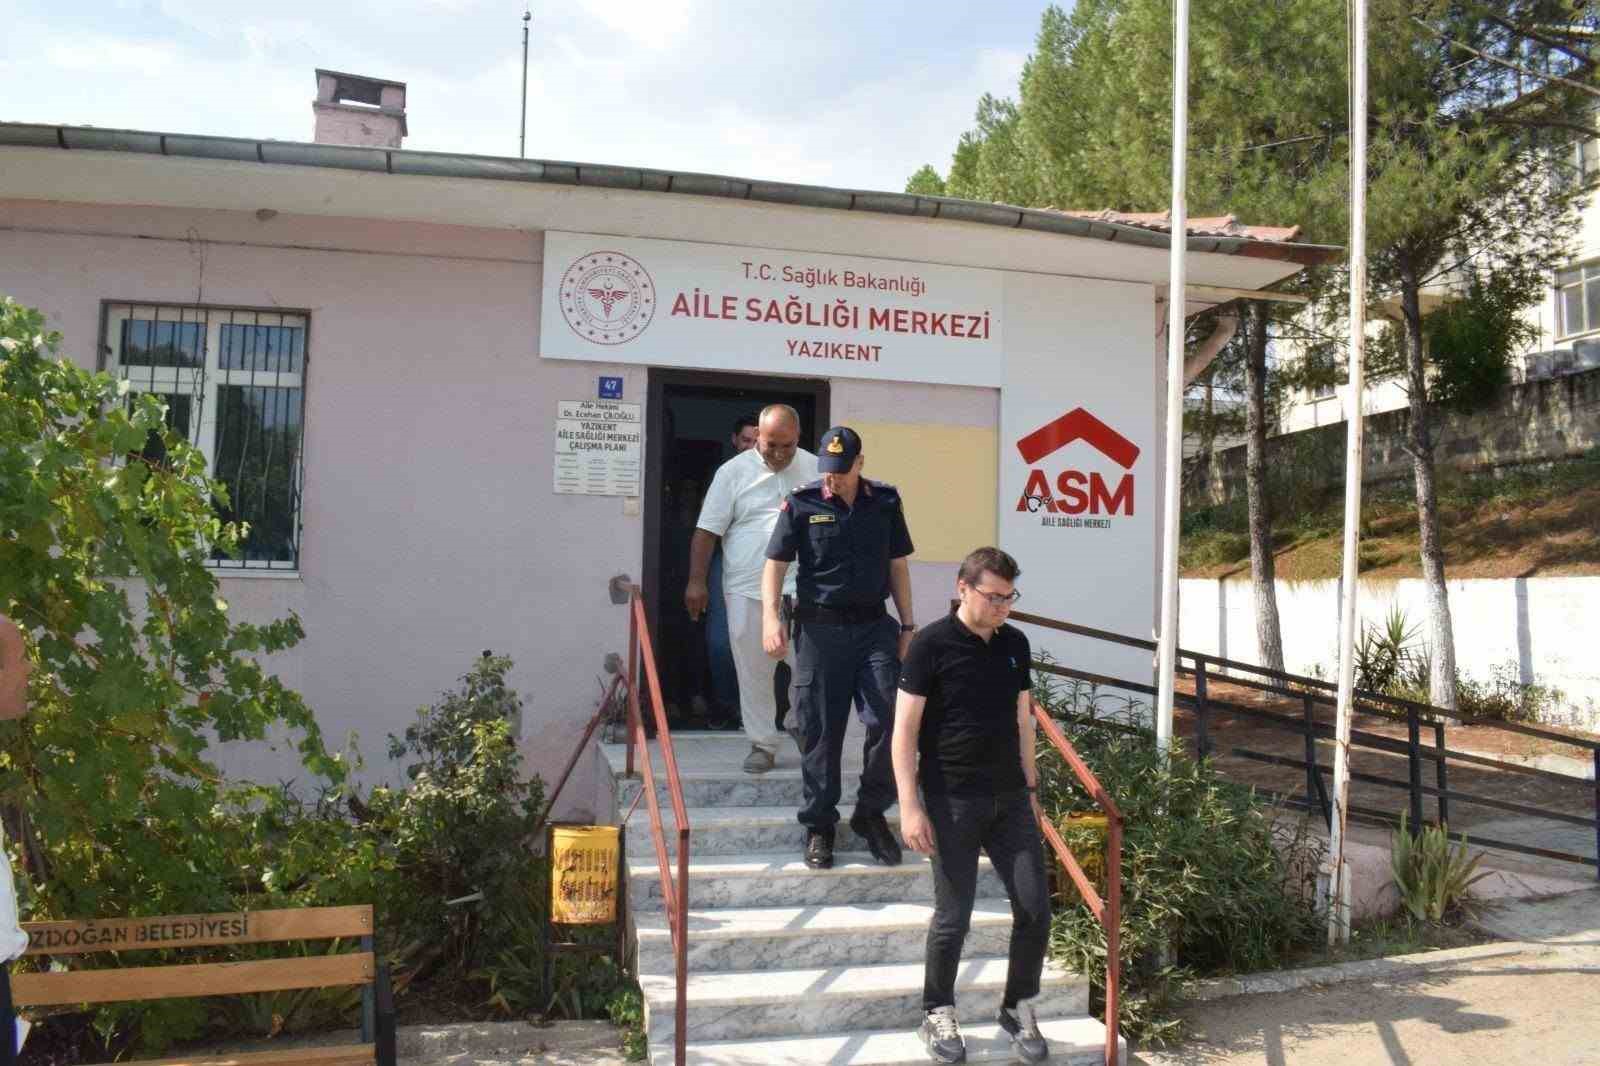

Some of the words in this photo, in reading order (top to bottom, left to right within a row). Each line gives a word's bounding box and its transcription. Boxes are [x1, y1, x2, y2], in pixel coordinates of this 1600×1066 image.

[741, 262, 777, 281] T.C.
[782, 266, 838, 288] Sağlık
[843, 271, 926, 297] Bakanlığı
[671, 287, 738, 320] AİLE
[745, 295, 859, 329] SAĞLIĞI
[868, 311, 990, 340] MERKEZİ
[785, 339, 883, 362] YAZIKENT
[604, 380, 617, 391] 47
[558, 428, 575, 440] AİLE
[575, 430, 606, 441] SAĞLIĞI
[607, 432, 640, 443] MERKEZİ
[581, 422, 617, 431] YAZIKENT
[569, 441, 603, 452] ÇALIŞMA
[604, 443, 627, 452] PLANI
[1016, 469, 1134, 516] ASM
[135, 914, 248, 942] BELEDİYESİ
